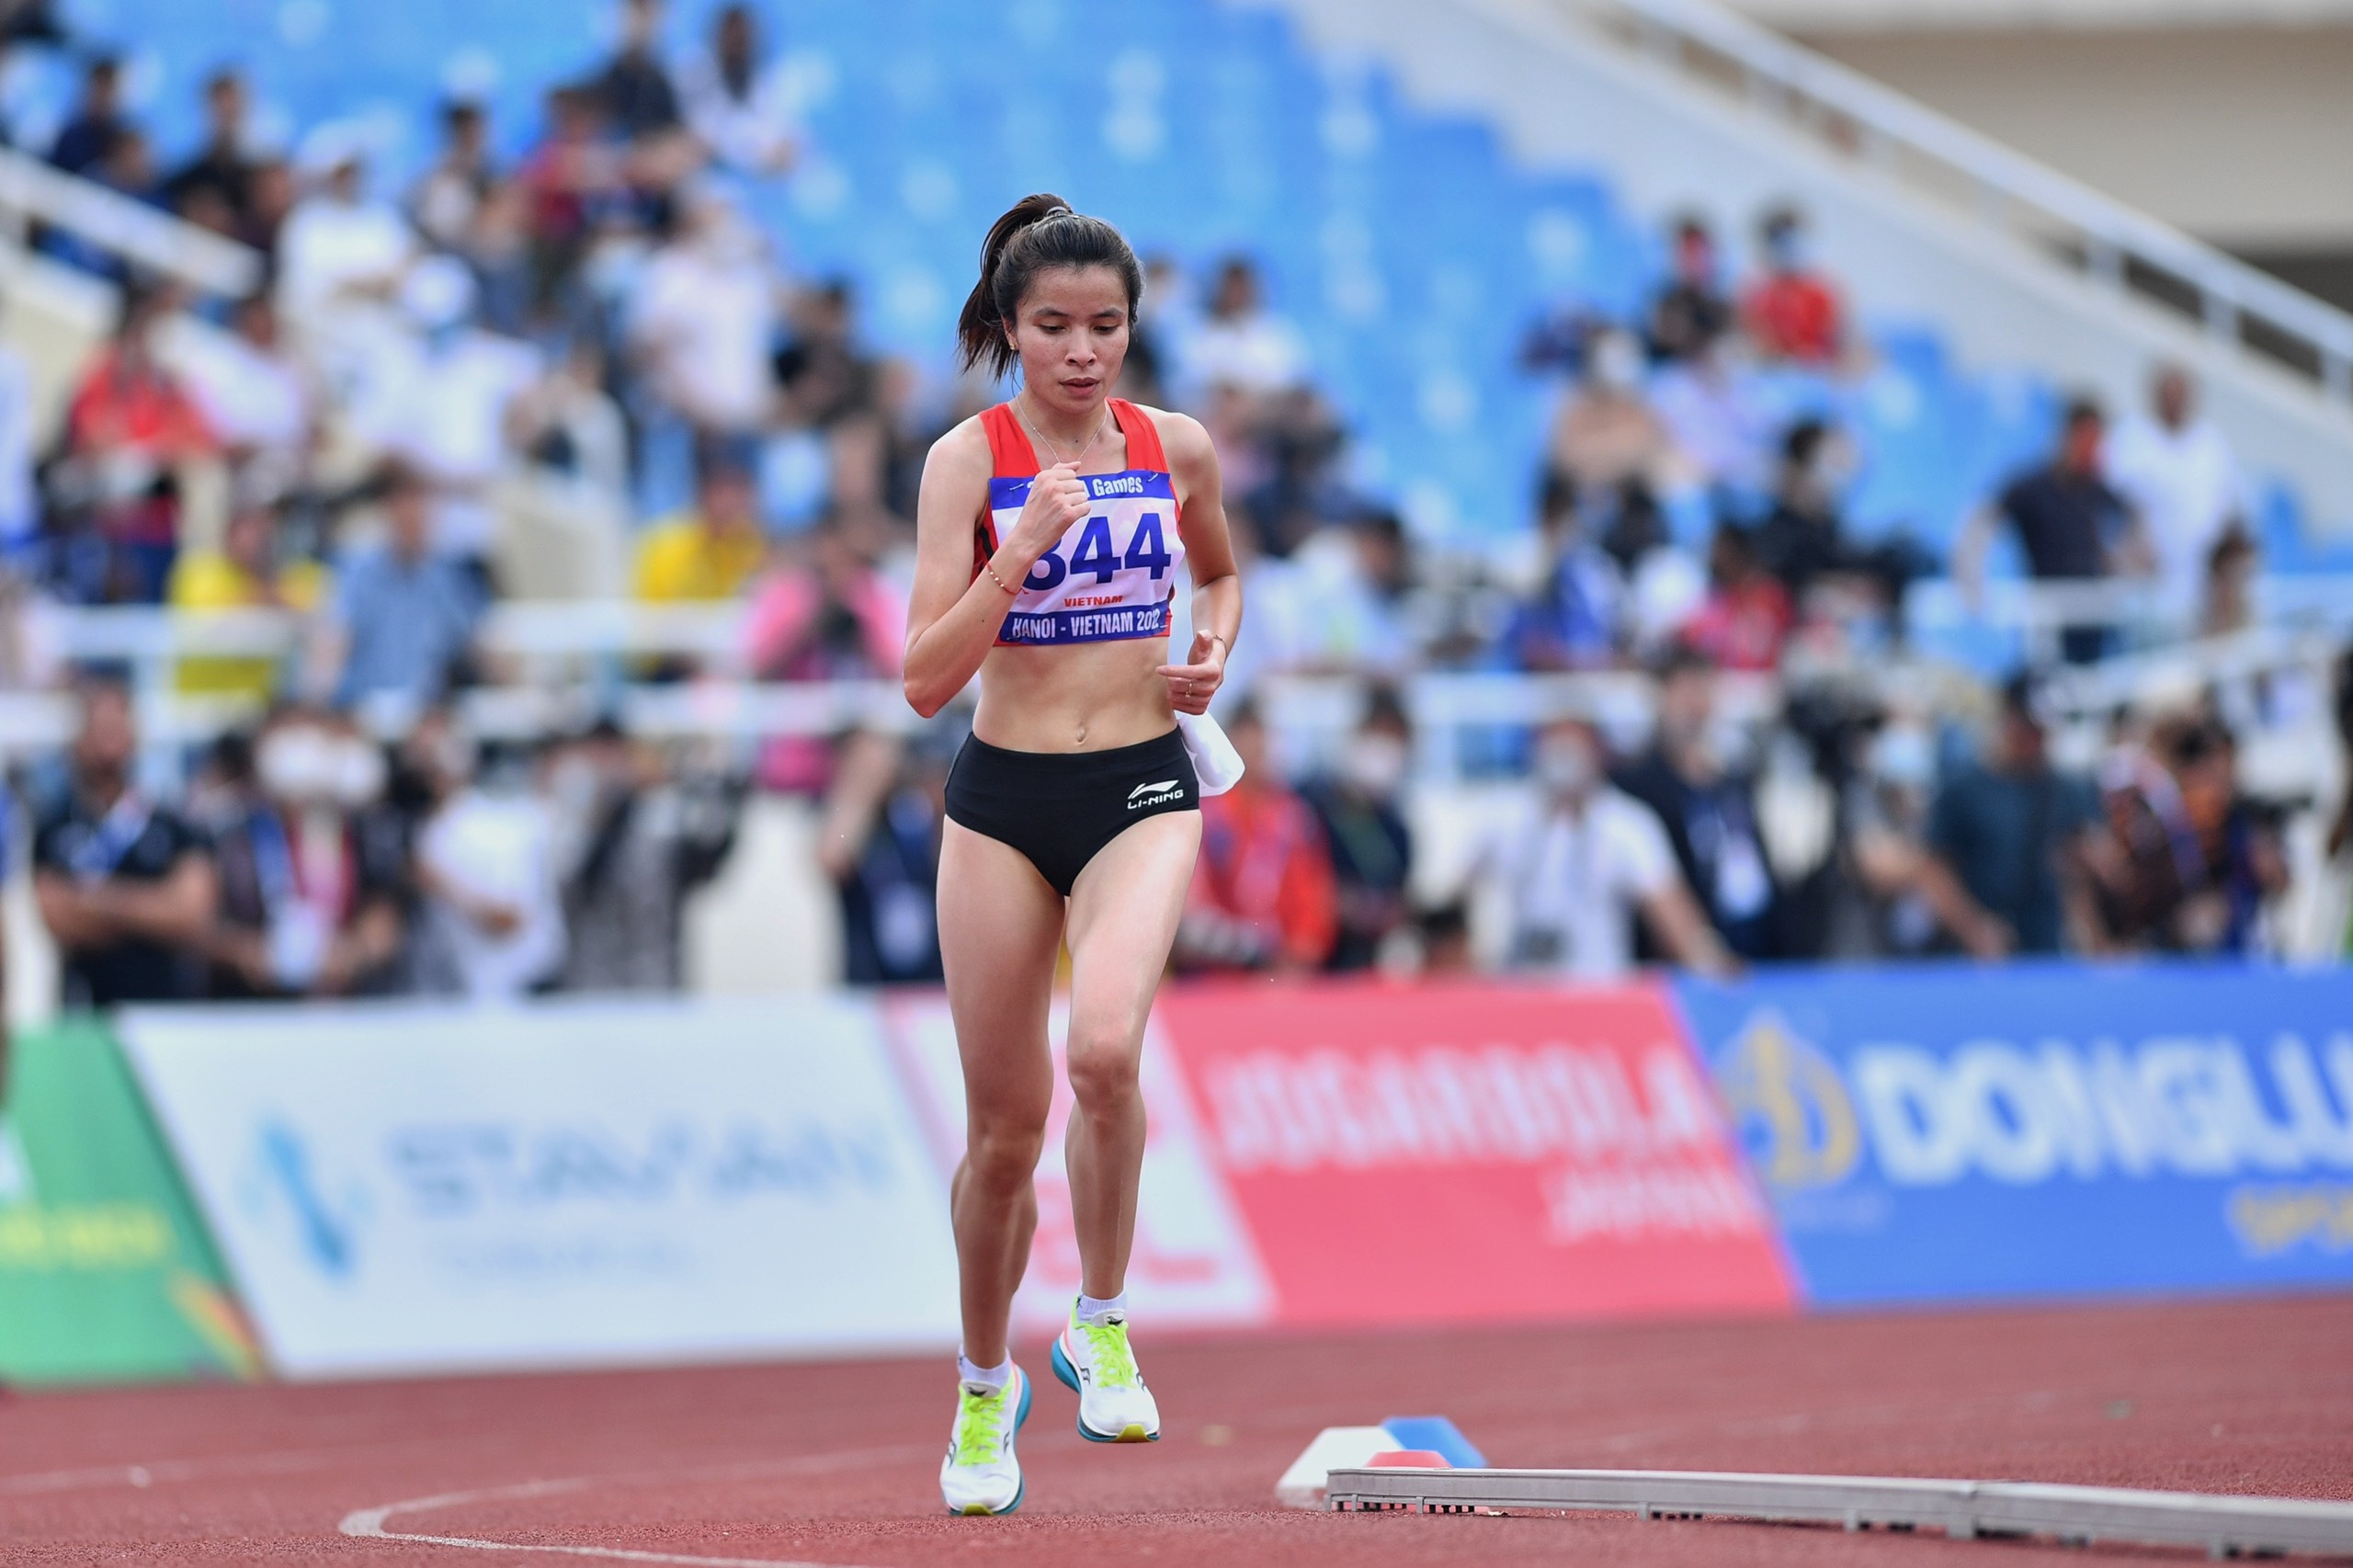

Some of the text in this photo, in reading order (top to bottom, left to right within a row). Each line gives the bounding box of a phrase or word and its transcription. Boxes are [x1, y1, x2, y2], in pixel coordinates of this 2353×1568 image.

[1092, 476, 1143, 497] Games
[1063, 596, 1123, 607] VIETNAM
[1012, 618, 1056, 639] HANOI
[1070, 611, 1133, 637] VIETNAM
[1127, 789, 1184, 810] LI-NING
